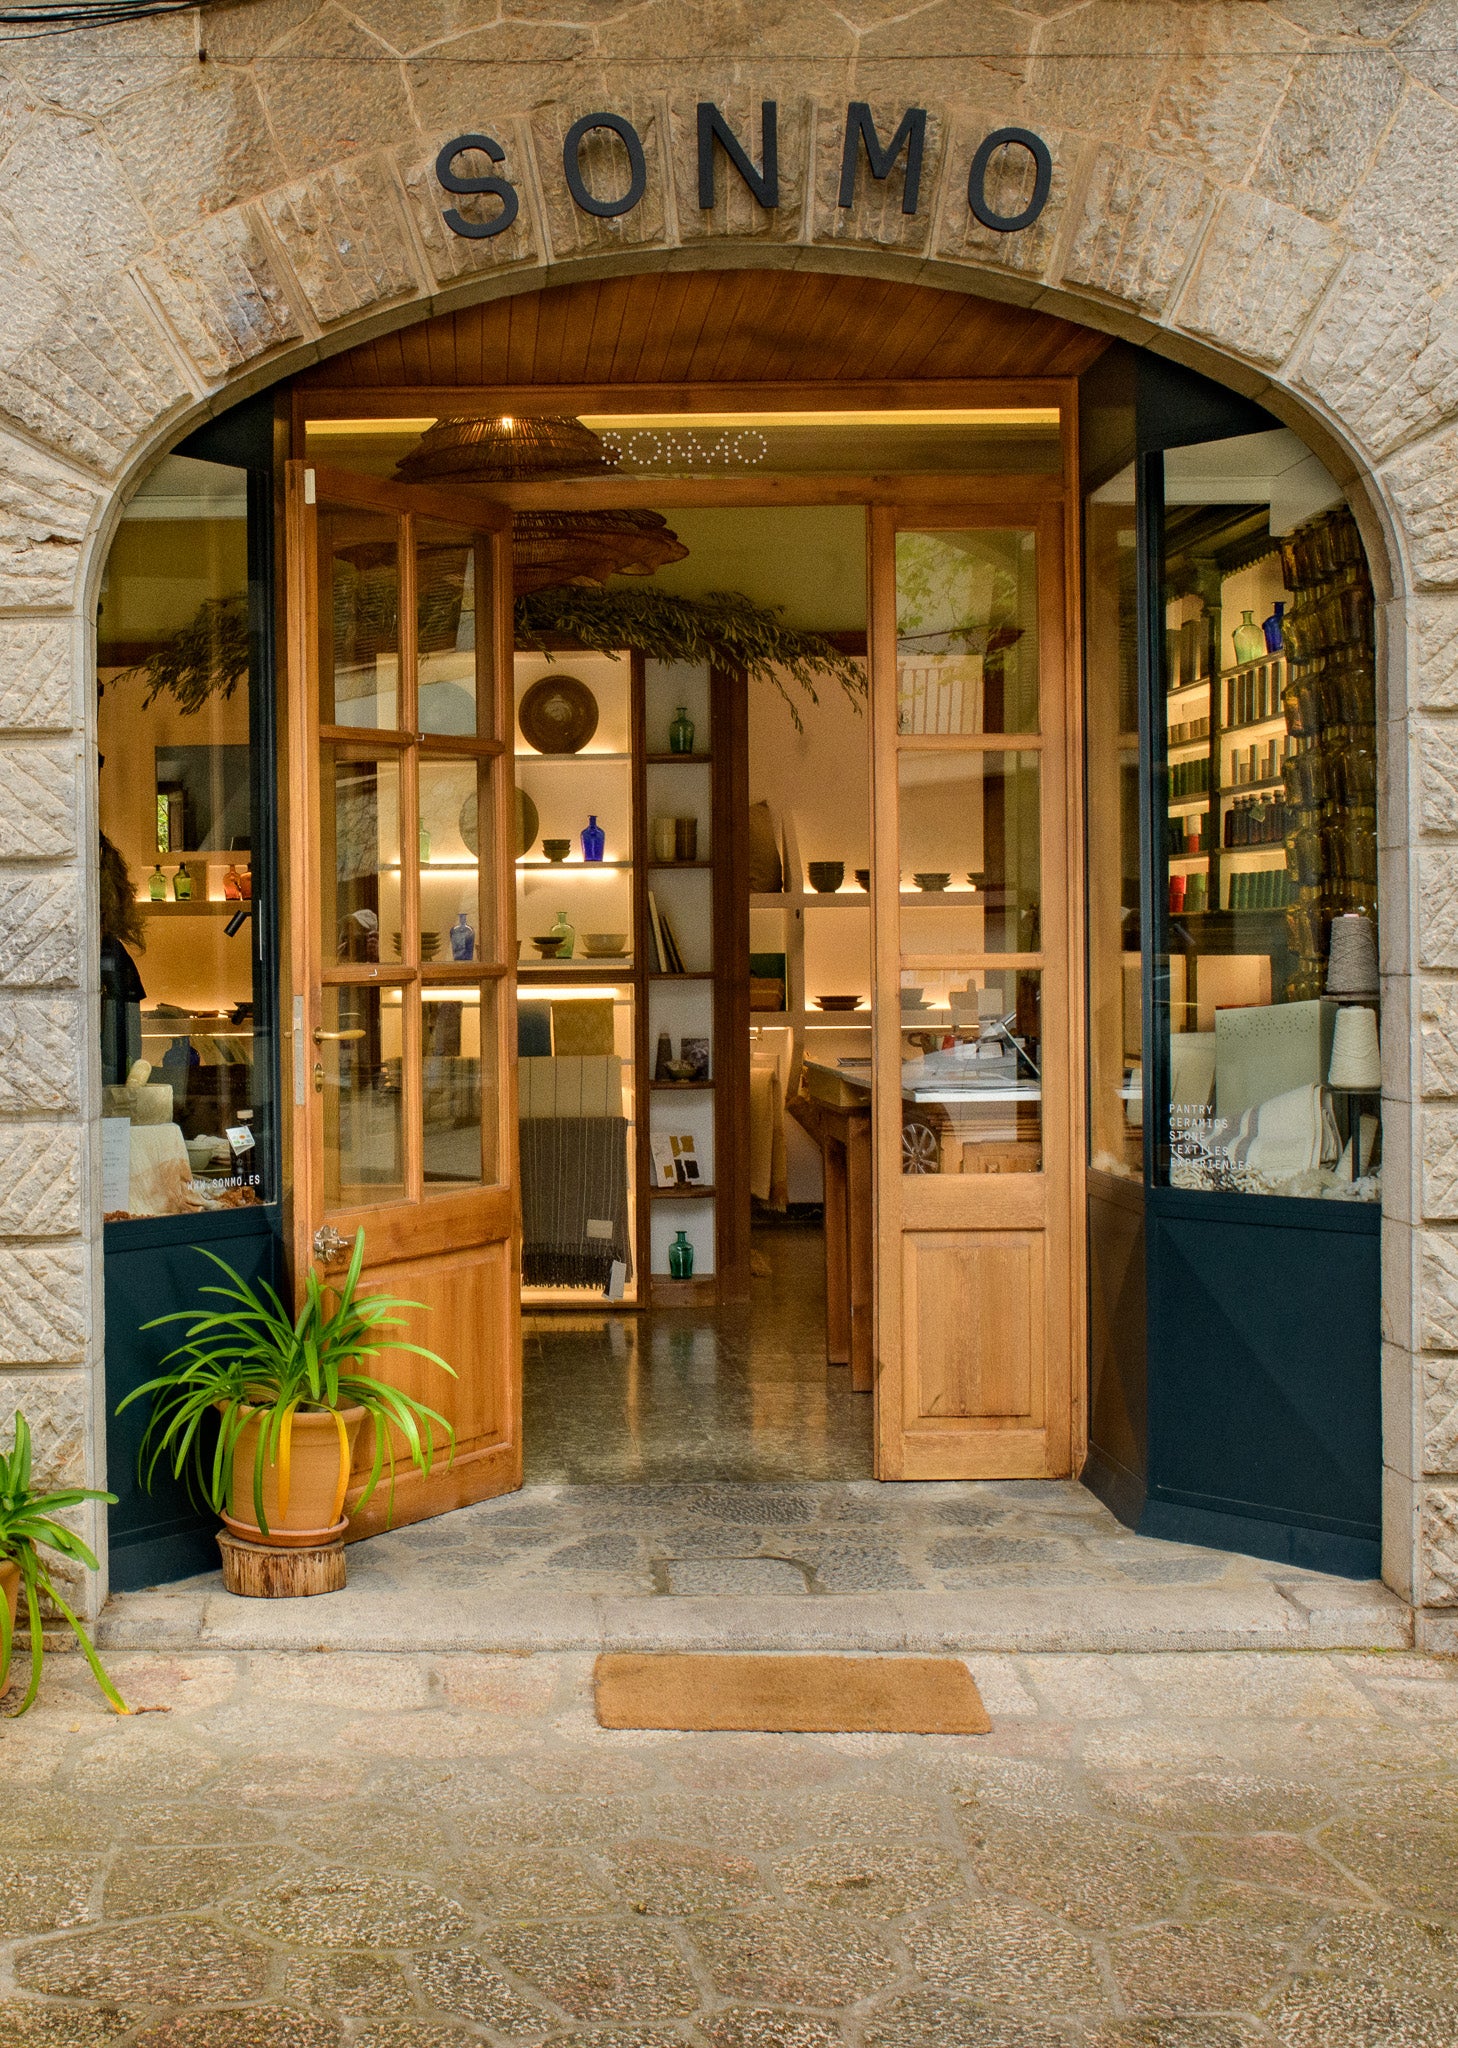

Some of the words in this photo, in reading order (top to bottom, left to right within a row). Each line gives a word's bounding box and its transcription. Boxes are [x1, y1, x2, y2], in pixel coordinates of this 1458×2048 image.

[434, 101, 1052, 239] SONMO
[601, 431, 767, 465] SONMO
[1169, 1104, 1213, 1114] PANTRY
[1169, 1117, 1229, 1129] CERAMICS
[1169, 1130, 1206, 1141] STONE
[1170, 1157, 1253, 1171] EXPERIENCES
[187, 1174, 260, 1191] WWW.SONMO.ES
